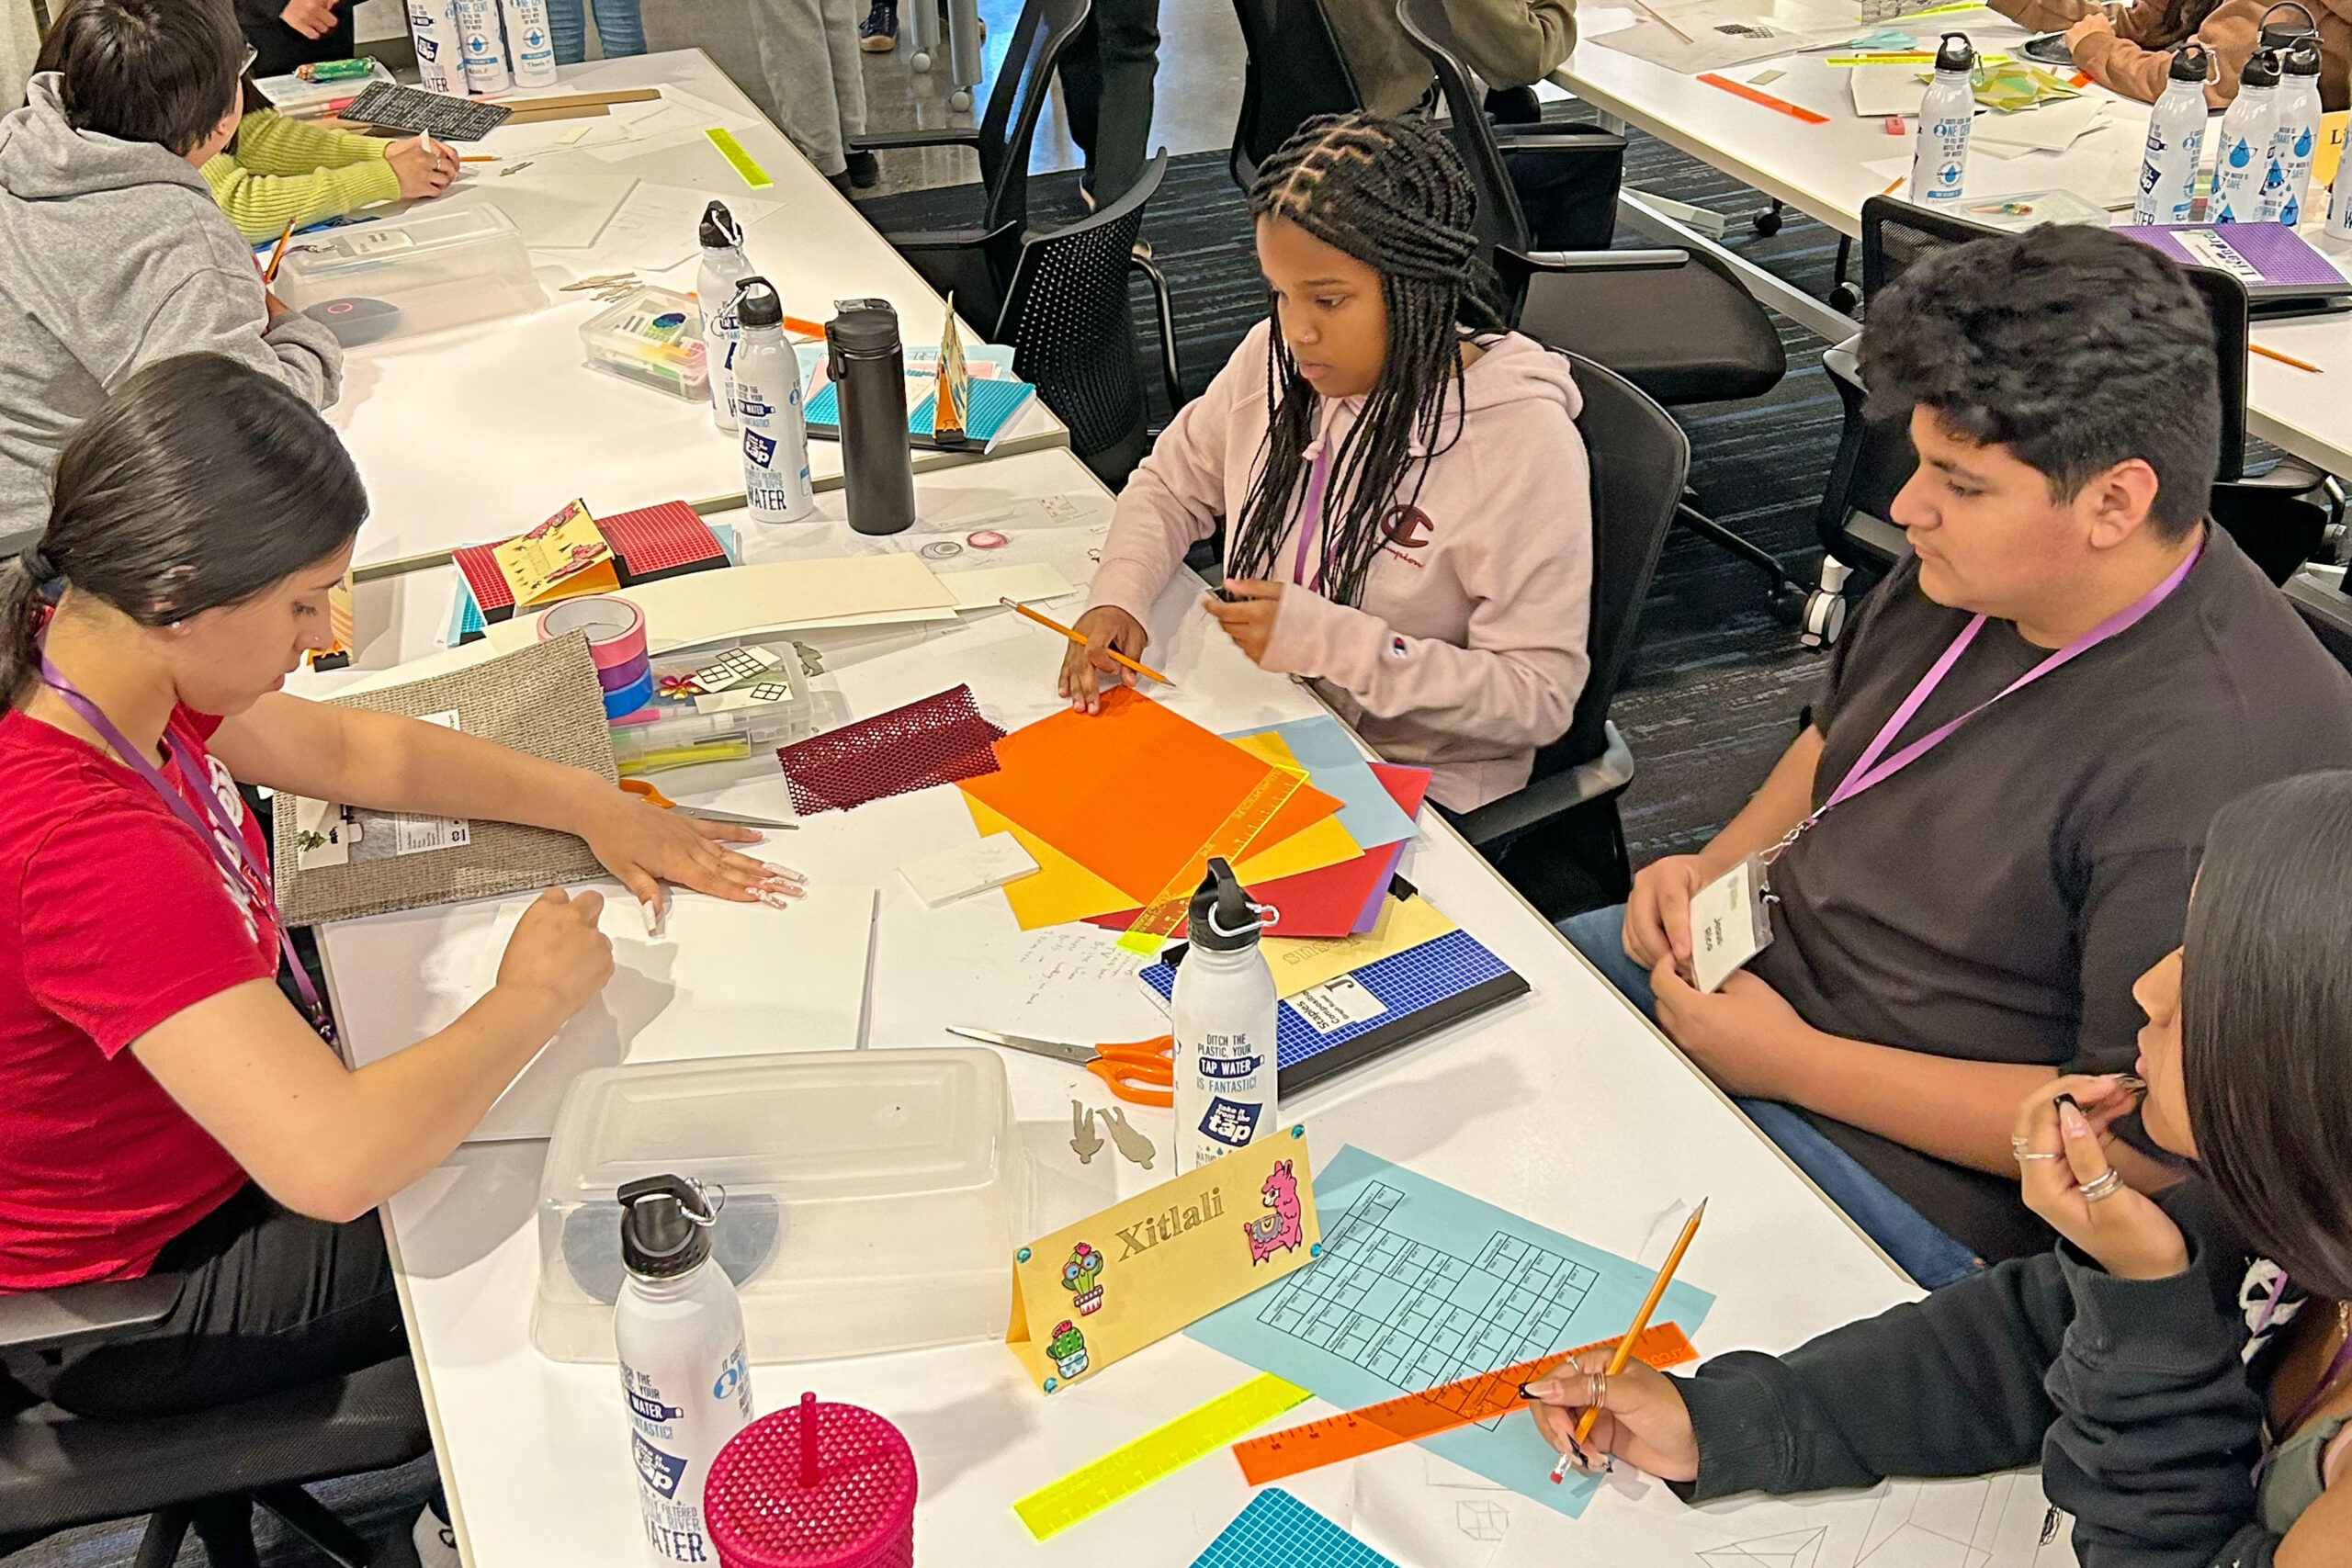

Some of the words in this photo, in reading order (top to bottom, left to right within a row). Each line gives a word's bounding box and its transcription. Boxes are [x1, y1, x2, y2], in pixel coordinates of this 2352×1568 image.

[1296, 1000, 1329, 1030] Staples
[1302, 990, 1340, 1024] Compositio
[1207, 1034, 1228, 1046] DITCH
[1233, 1033, 1246, 1044] THE
[1198, 1043, 1228, 1058] PLASTIC,
[1233, 1043, 1251, 1056] YOUR
[1202, 1060, 1218, 1074] TAP
[1222, 1060, 1251, 1075] WATER
[1196, 1077, 1204, 1089] IS
[1209, 1075, 1257, 1093] FANTASTIC!
[1208, 1115, 1251, 1143] tap
[1115, 1187, 1225, 1262] Xitlali
[637, 1371, 651, 1387] THE
[639, 1386, 661, 1400] YOUR
[632, 1394, 663, 1419] WATER
[662, 1504, 698, 1517] FILTERED
[667, 1517, 701, 1531] RIVER
